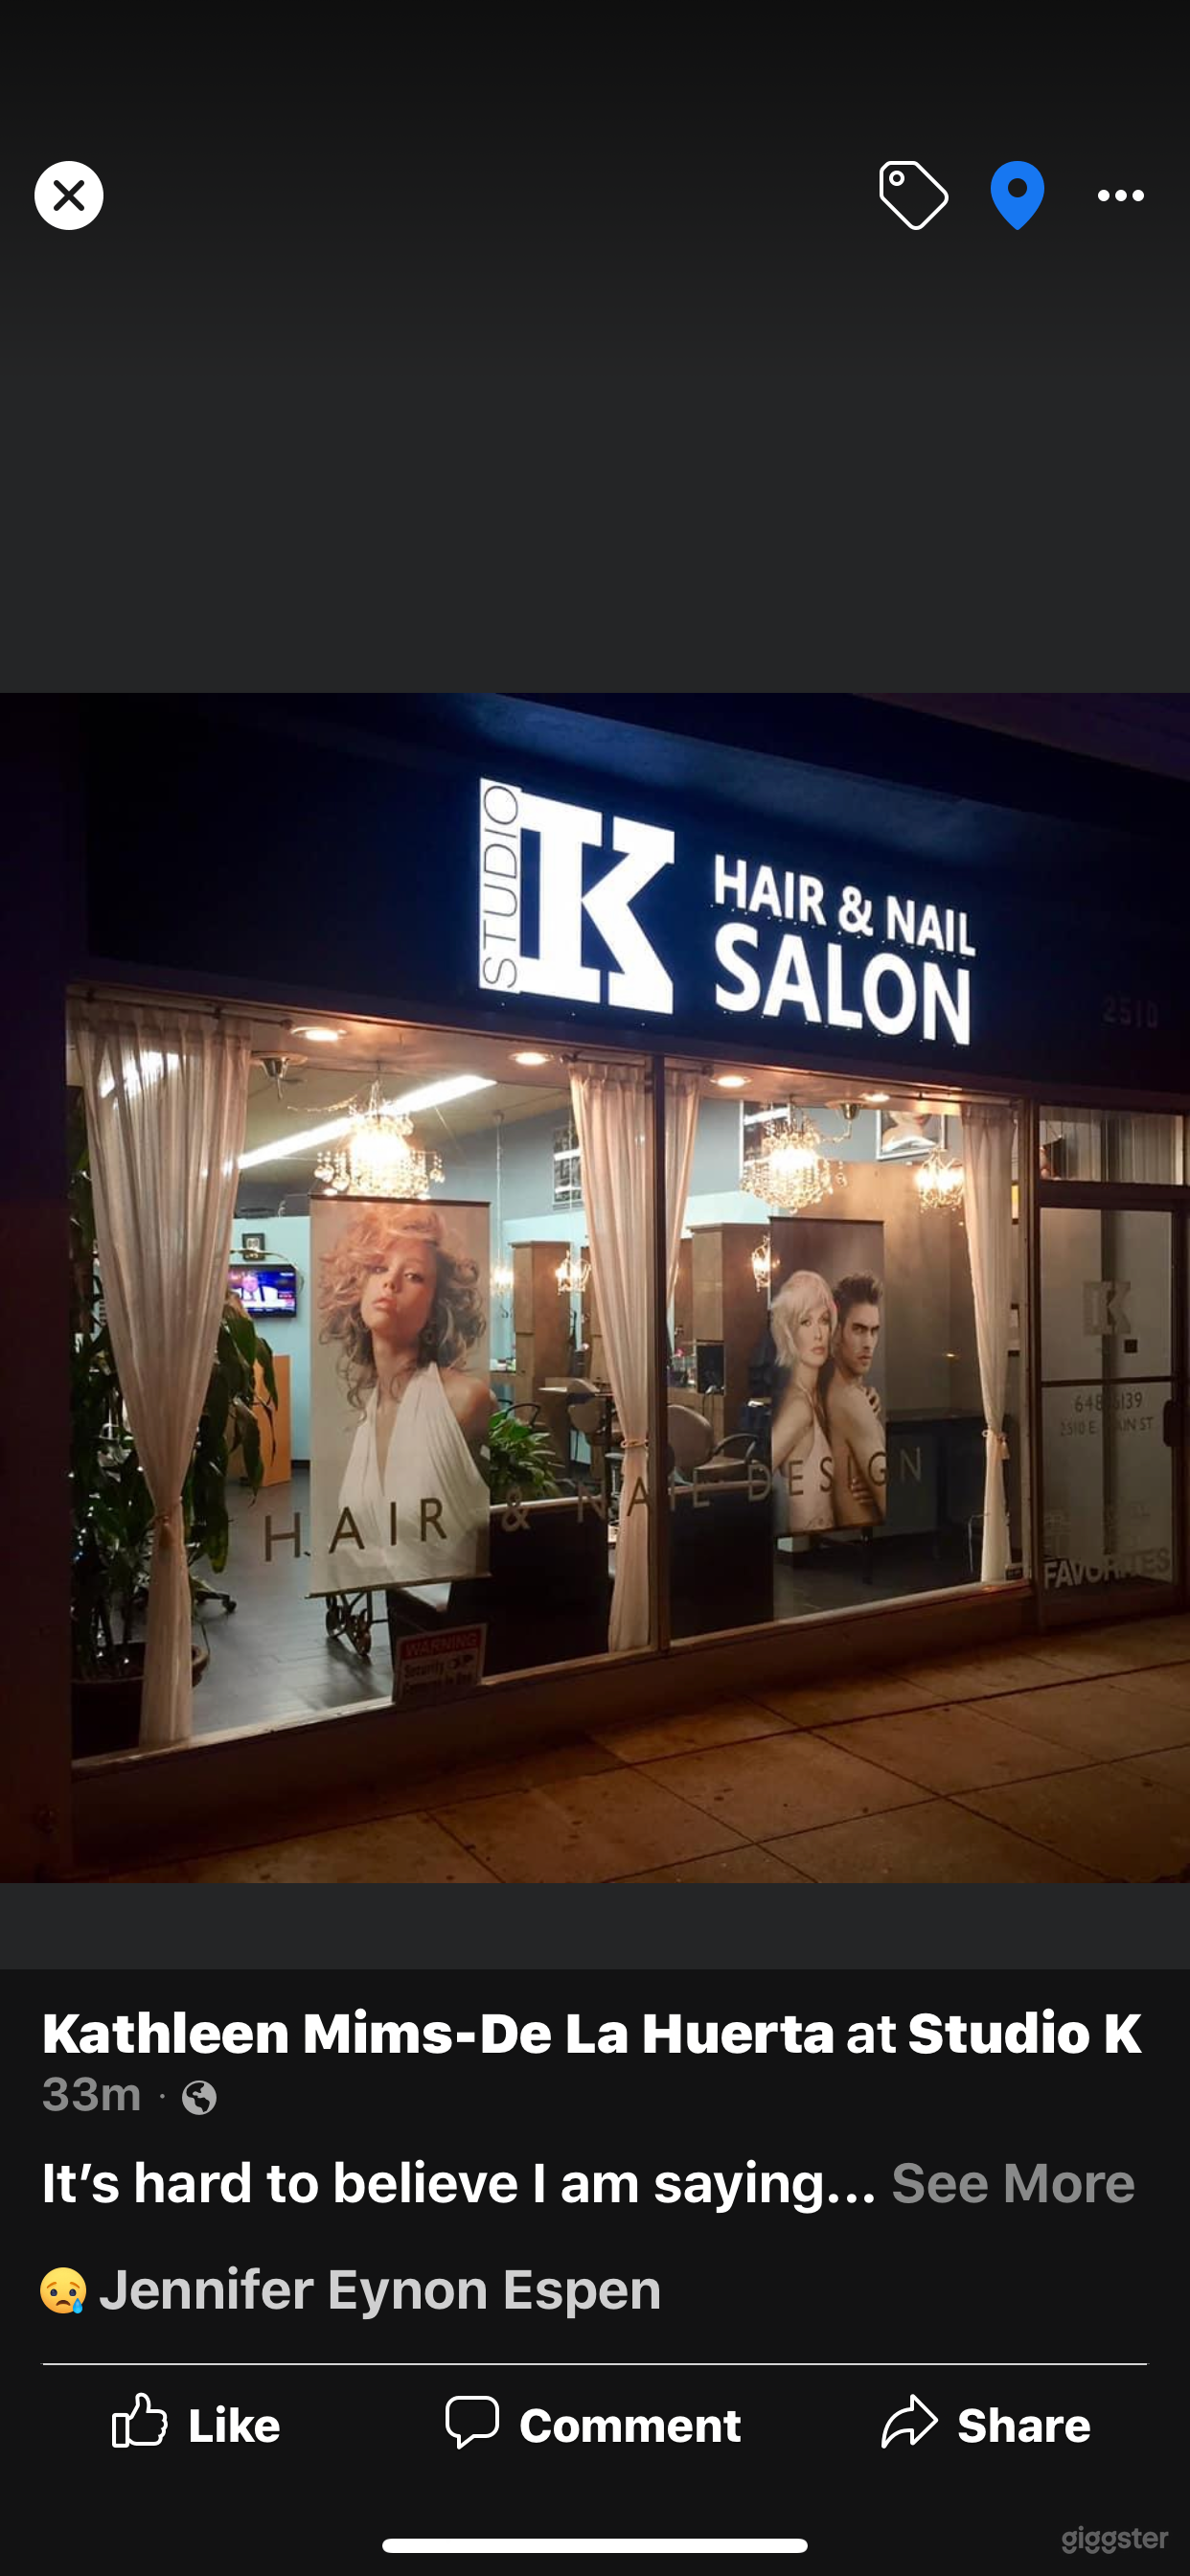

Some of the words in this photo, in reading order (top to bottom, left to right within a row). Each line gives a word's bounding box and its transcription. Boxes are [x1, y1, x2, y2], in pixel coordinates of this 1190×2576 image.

[483, 785, 519, 988] STUDIO
[519, 791, 675, 1015] K
[715, 854, 827, 927] HAIR
[837, 886, 874, 936] &
[886, 895, 976, 956] NAIL
[715, 922, 971, 1046] SALON
[264, 1497, 447, 1562] HAIR
[501, 1486, 531, 1531] &
[747, 1446, 922, 1502] DESIGN
[405, 1632, 477, 1658] WARNING
